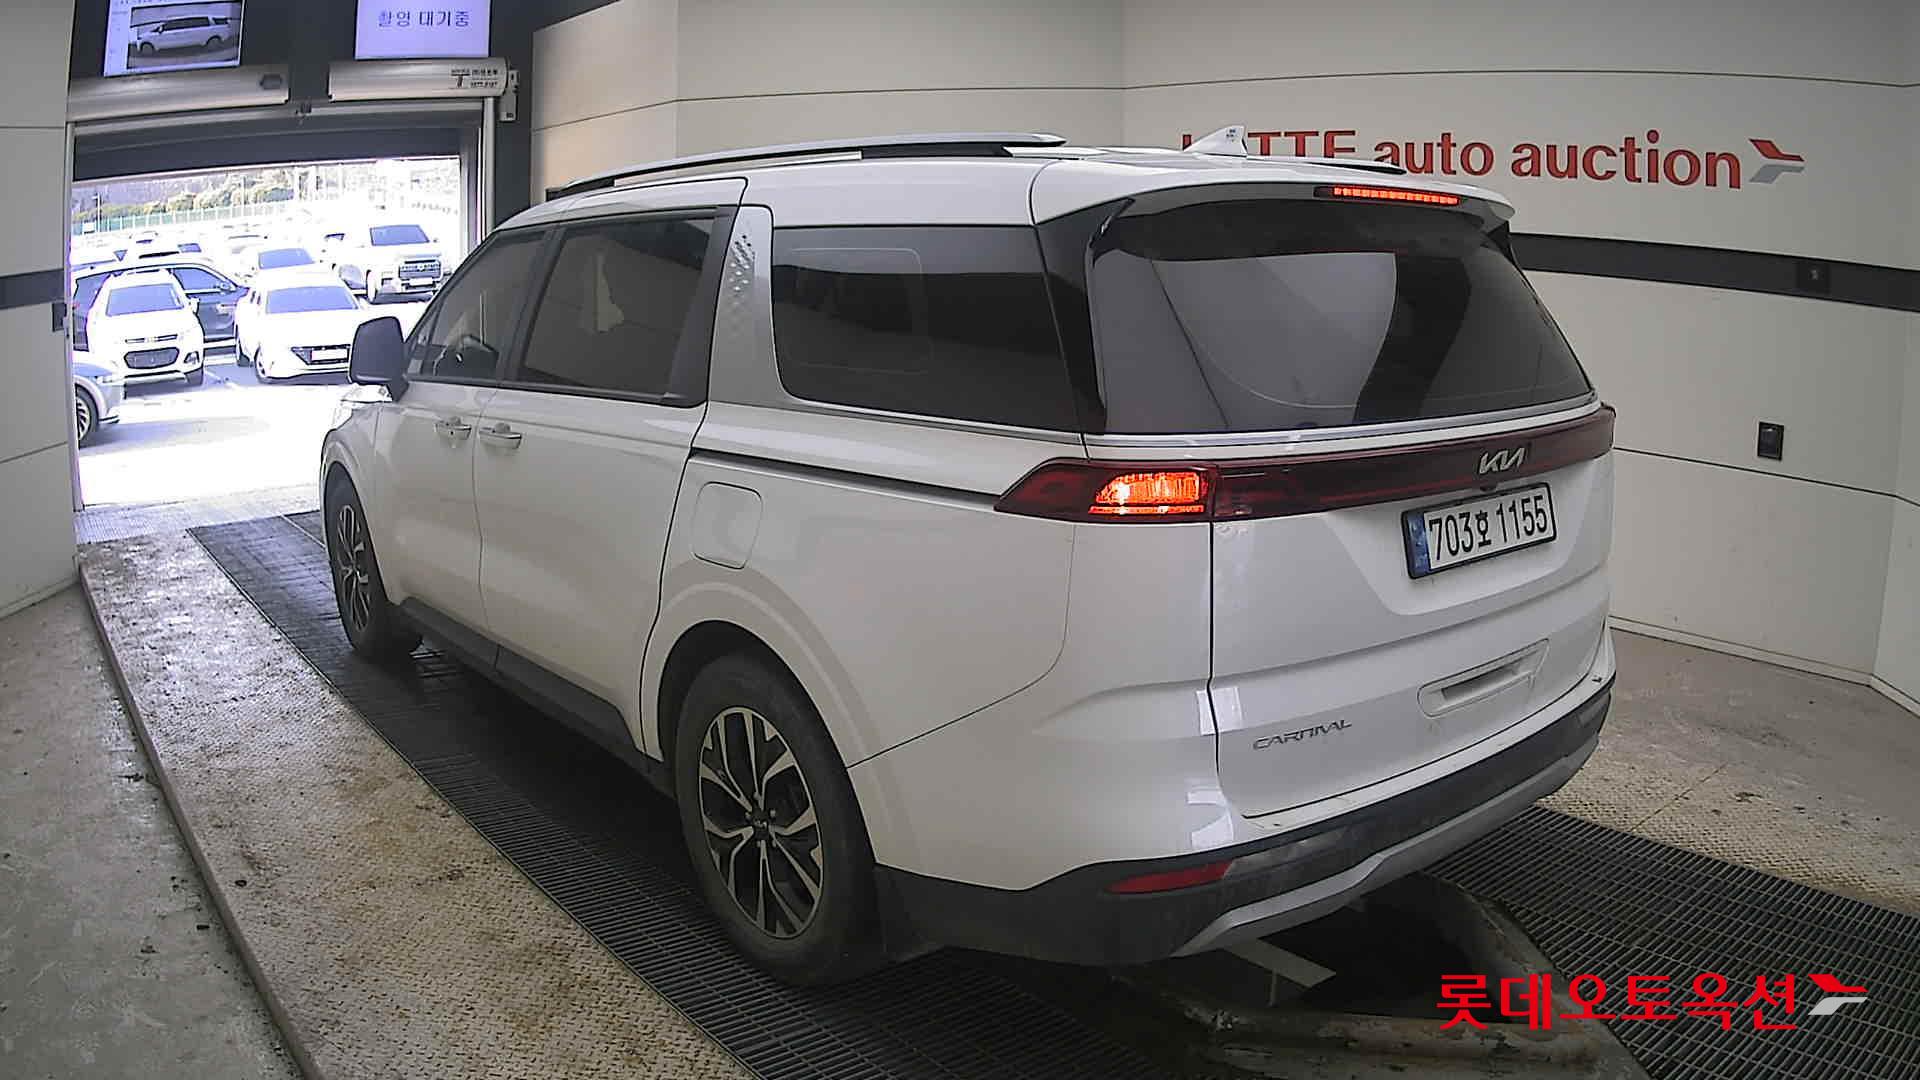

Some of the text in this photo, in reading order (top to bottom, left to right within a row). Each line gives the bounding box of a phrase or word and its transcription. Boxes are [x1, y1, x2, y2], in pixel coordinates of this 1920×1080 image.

[419, 10, 470, 27] 대기중
[1374, 132, 1495, 176] auto
[1510, 129, 1741, 189] auction
[1428, 495, 1548, 561] 703호 1155
[1253, 719, 1352, 750] CARNIVAL
